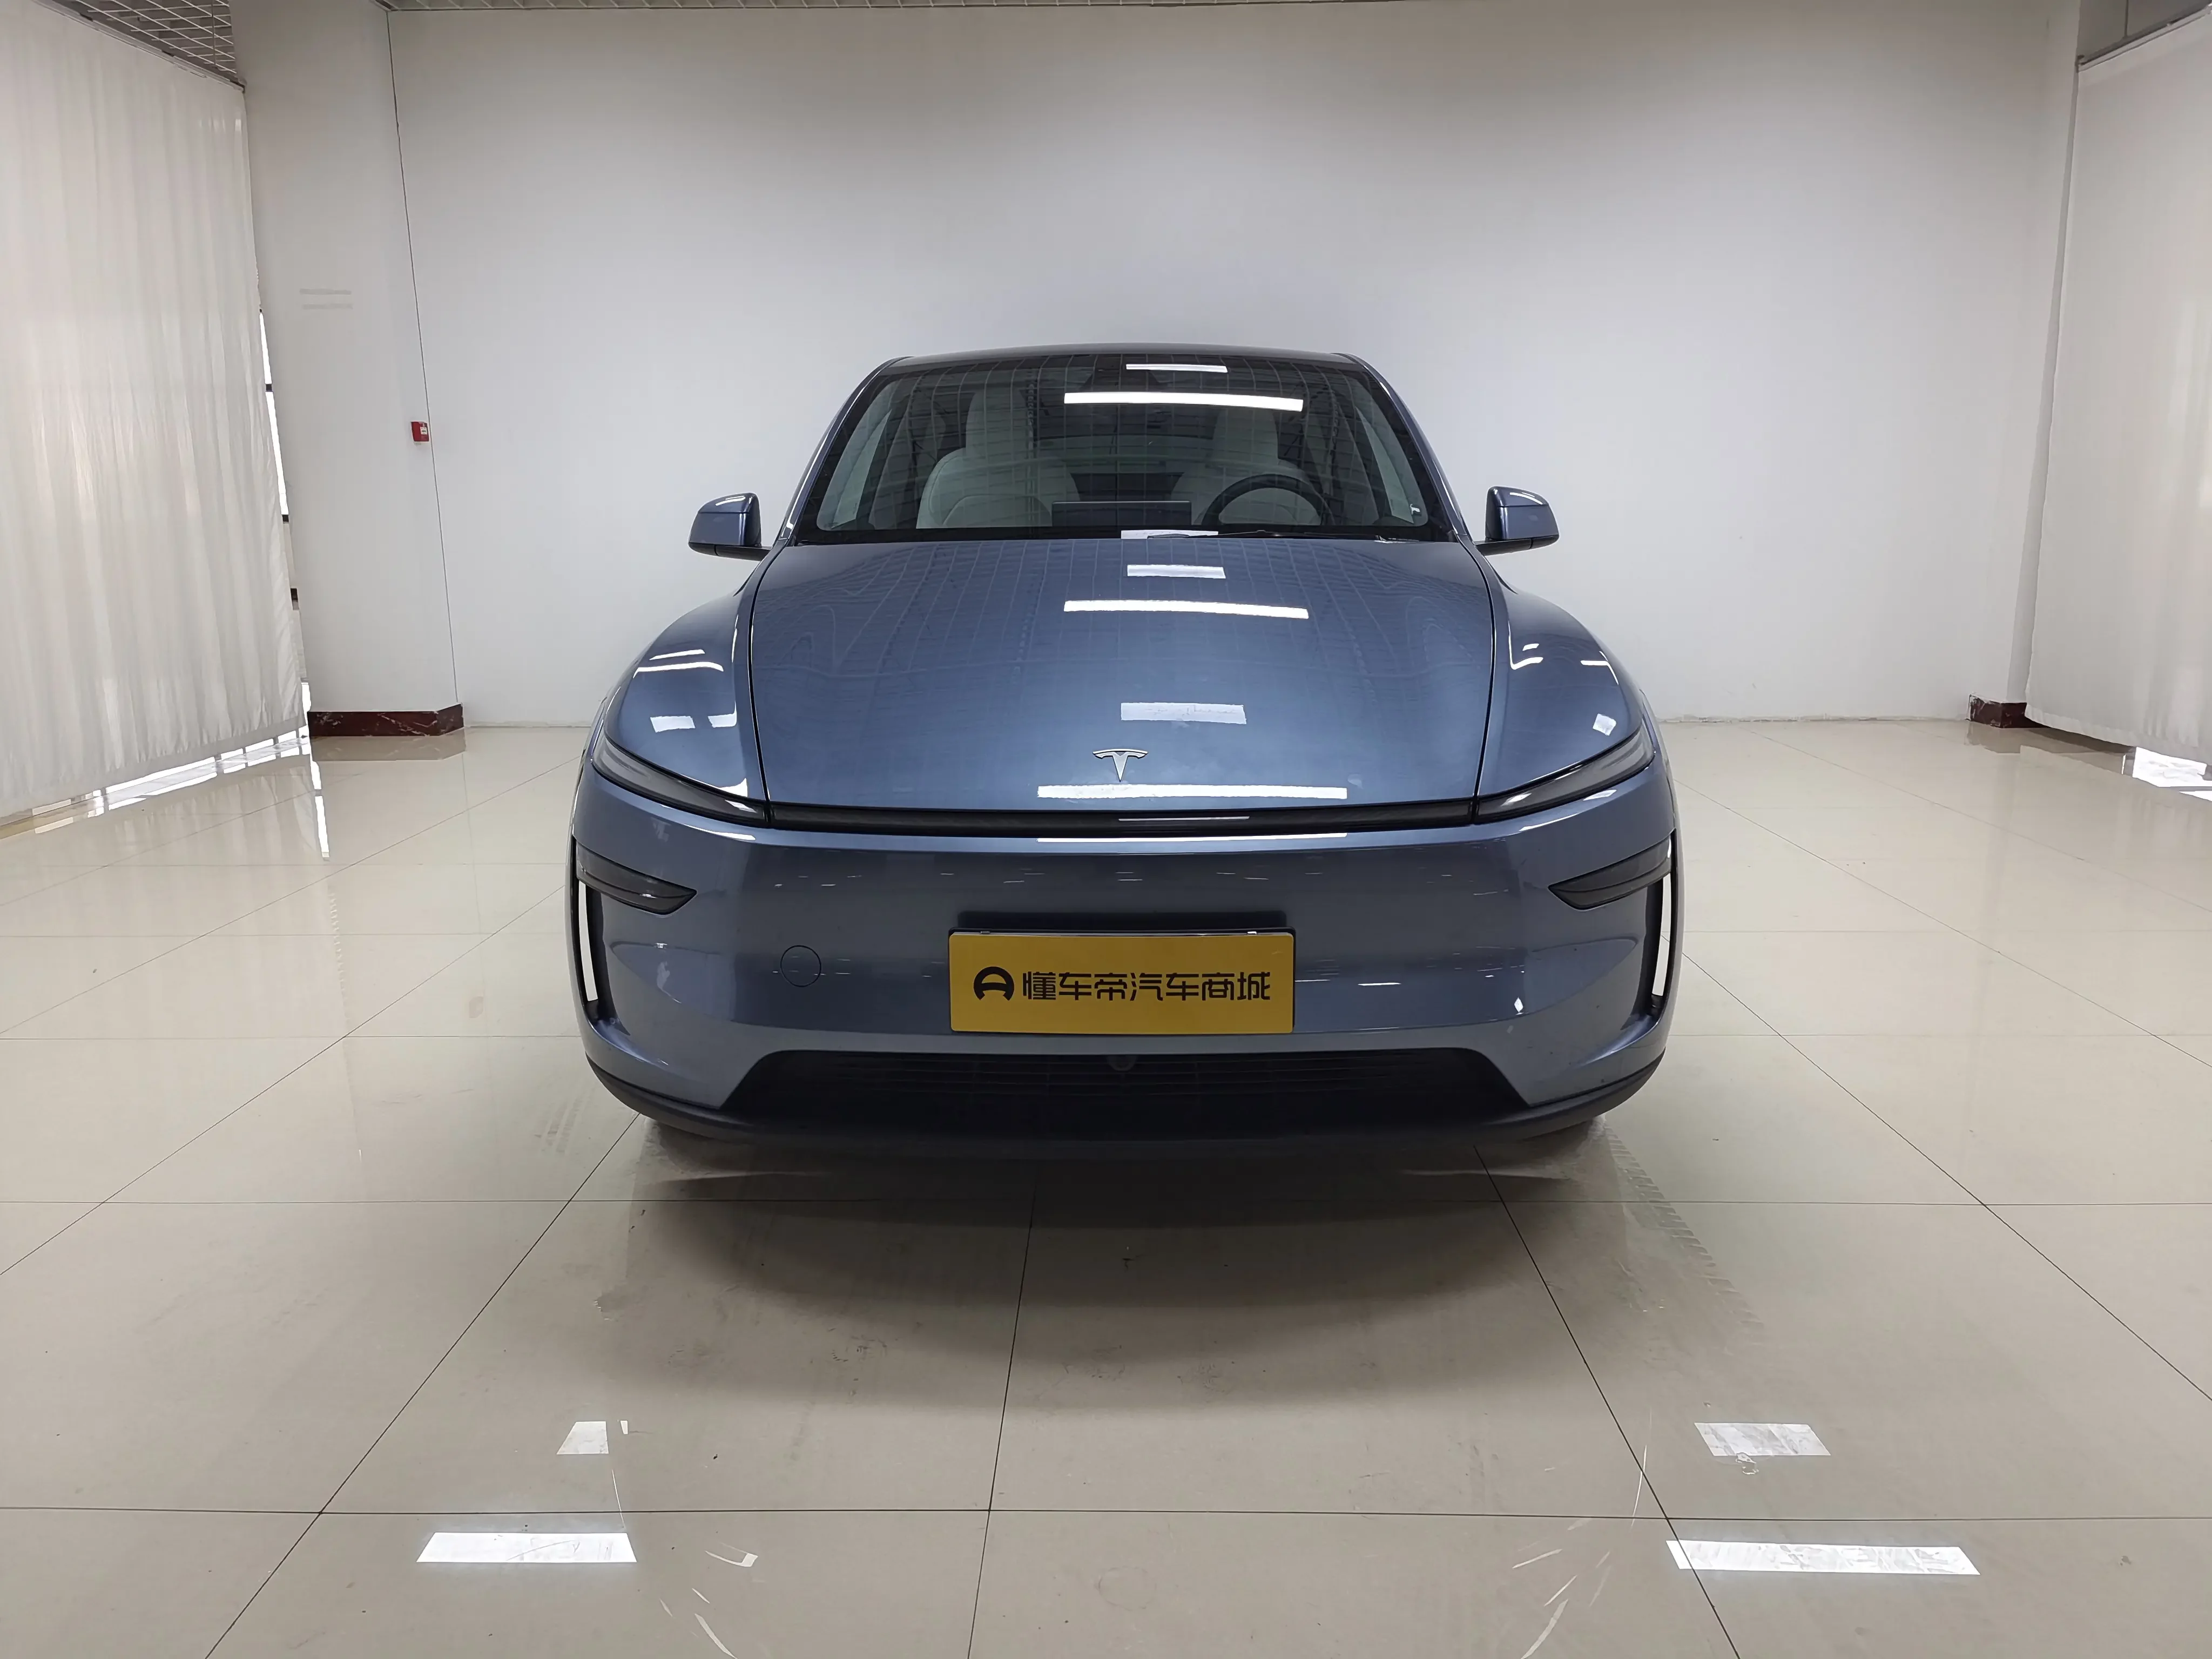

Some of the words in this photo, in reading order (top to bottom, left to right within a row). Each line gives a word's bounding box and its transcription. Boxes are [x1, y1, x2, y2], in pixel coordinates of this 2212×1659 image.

[1022, 972, 1271, 1001] 懂车帝汽车商城
